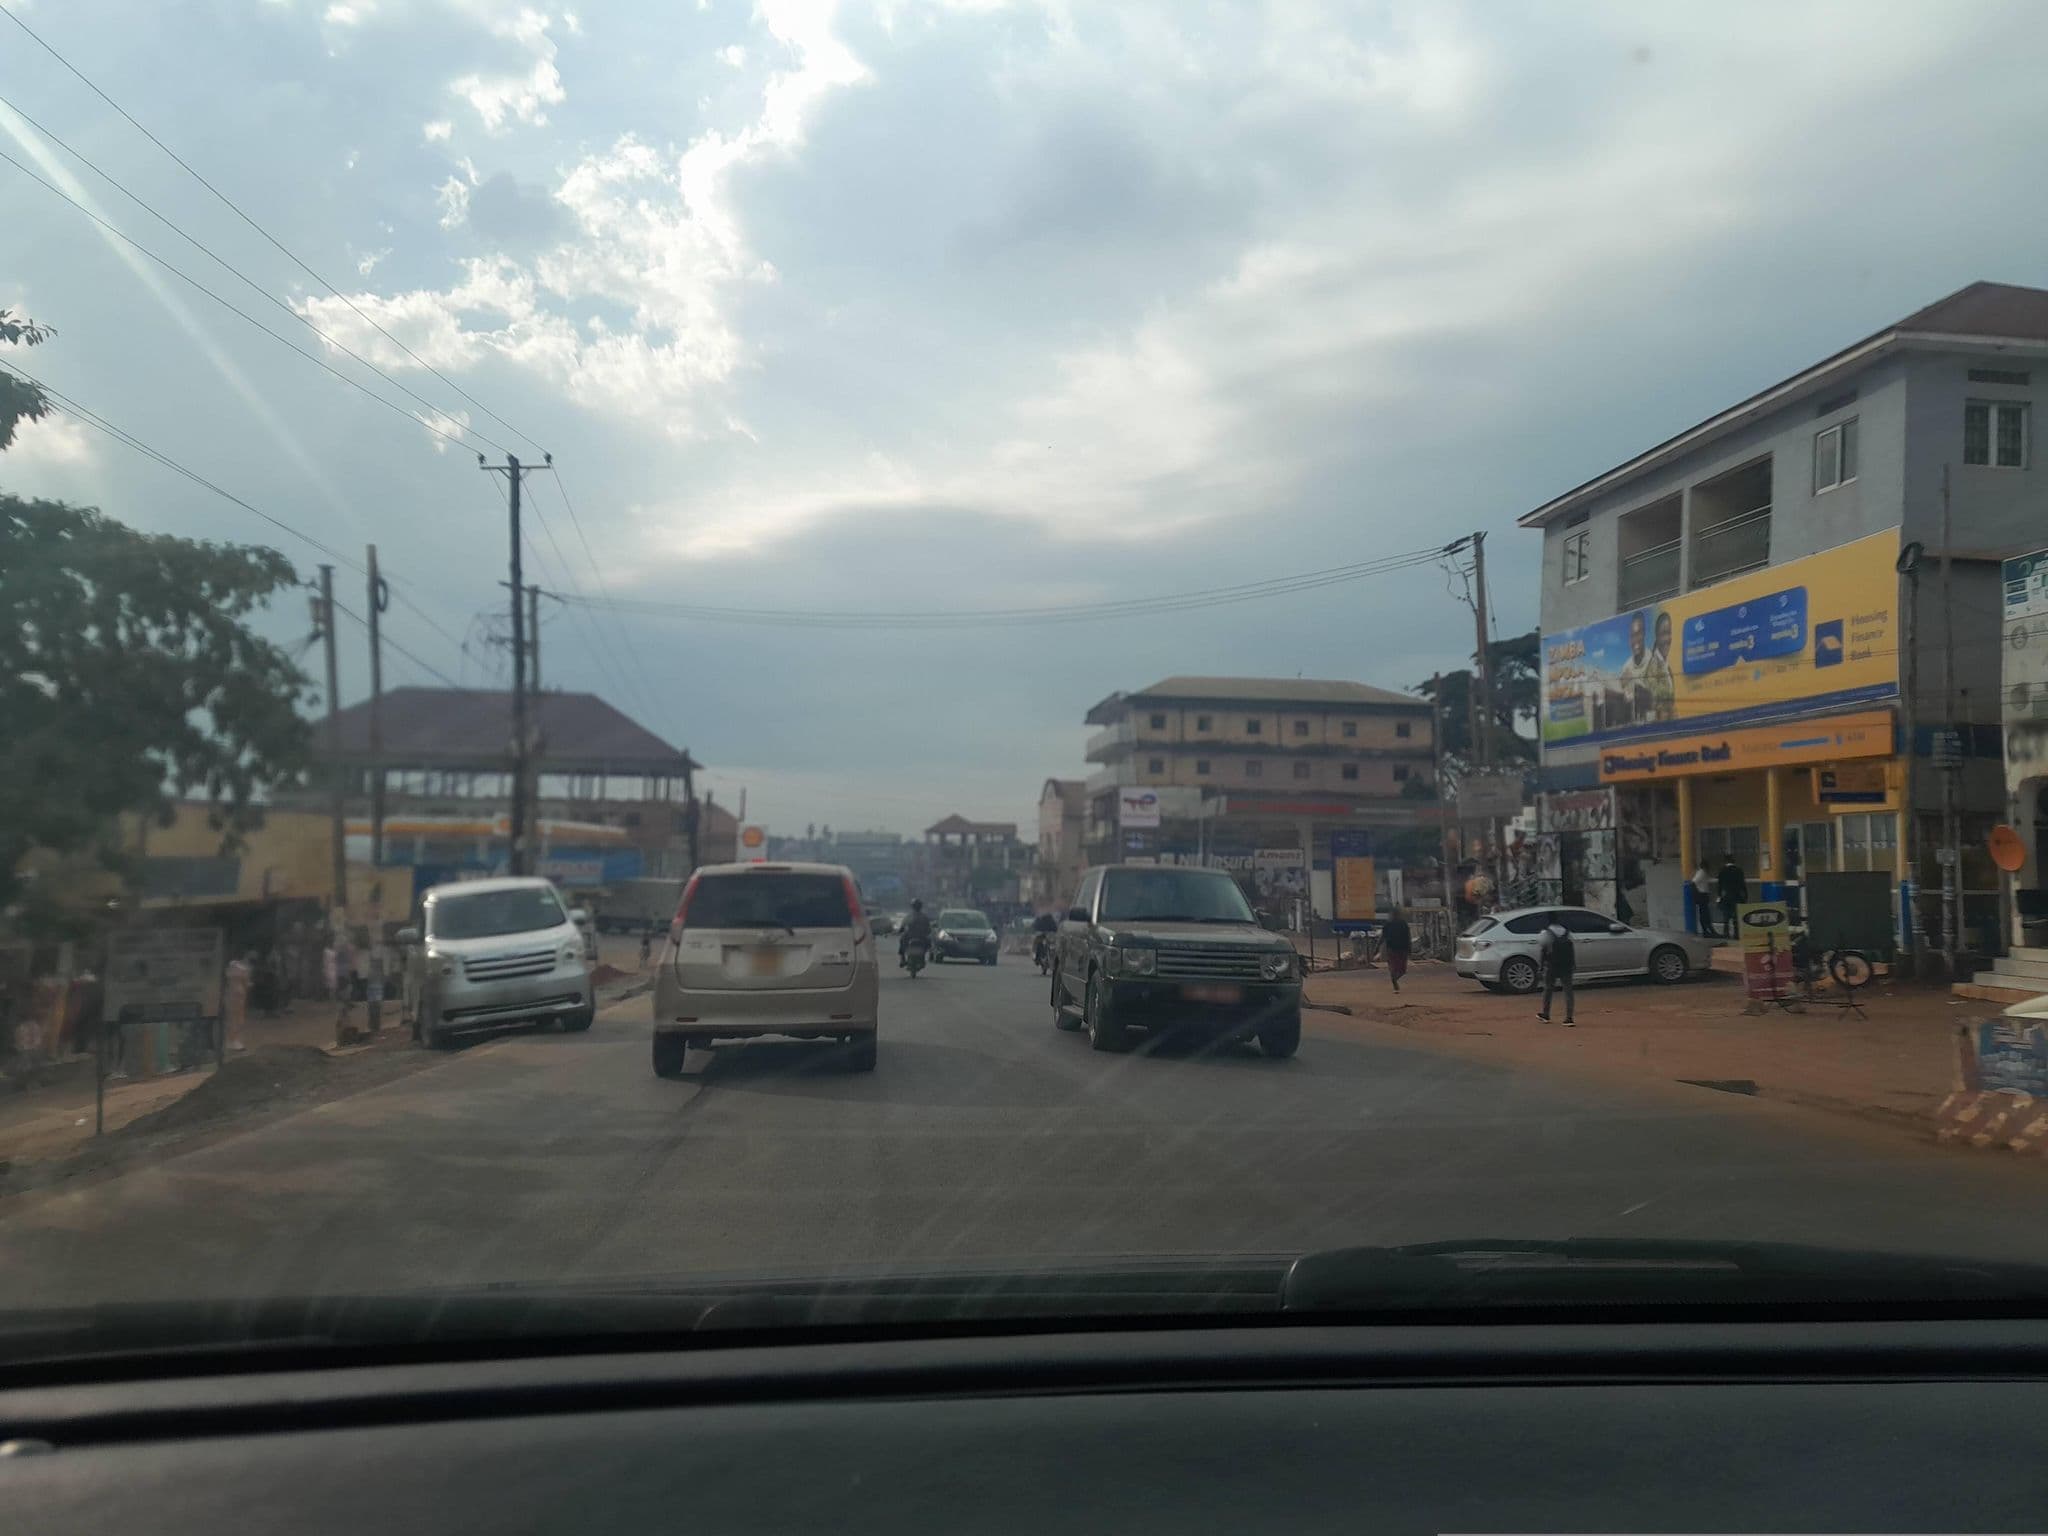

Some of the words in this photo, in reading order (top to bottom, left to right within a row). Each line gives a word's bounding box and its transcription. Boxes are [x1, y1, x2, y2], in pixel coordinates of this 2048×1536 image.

[1851, 609, 1888, 627] Housing
[1851, 629, 1885, 644] Finance
[1614, 752, 1657, 773] Housing
[1658, 749, 1699, 766] Finance
[1701, 741, 1730, 762] Bank
